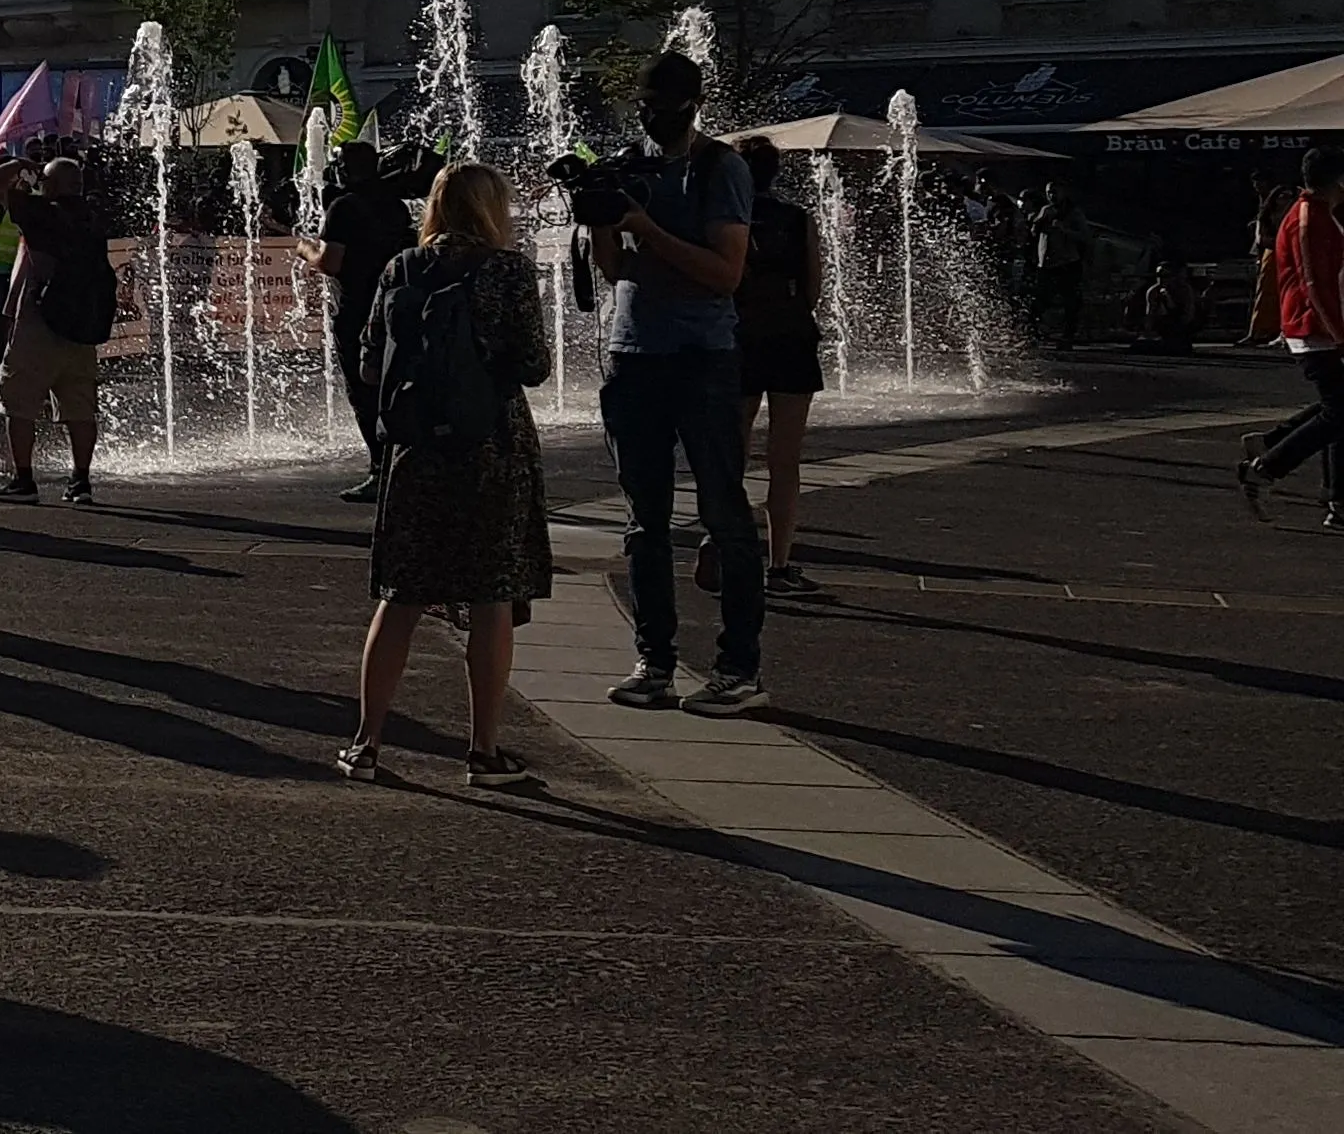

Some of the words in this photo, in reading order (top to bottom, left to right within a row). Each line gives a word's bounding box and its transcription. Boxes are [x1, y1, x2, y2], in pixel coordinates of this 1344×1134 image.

[1106, 134, 1167, 152] Bräu
[1184, 133, 1242, 151] Cafe
[1261, 133, 1312, 149] Bar
